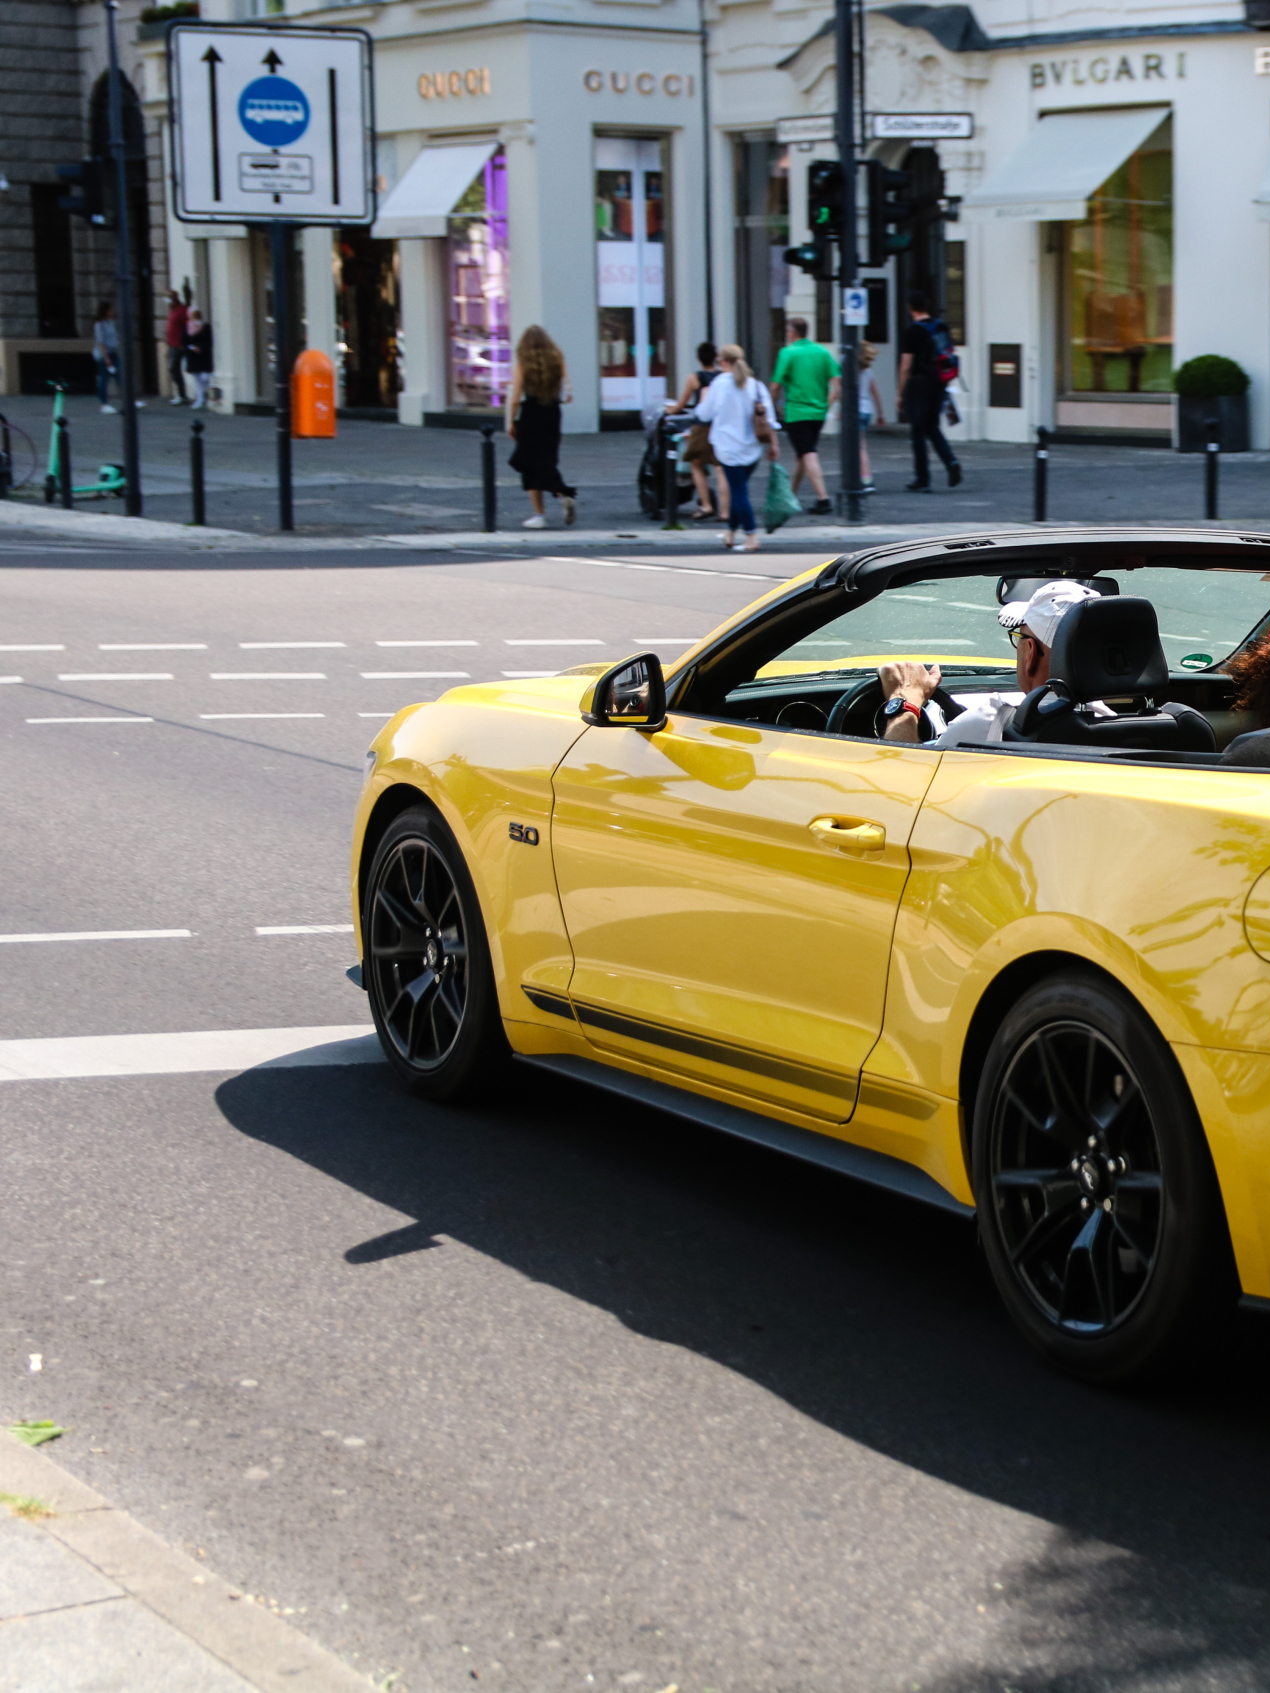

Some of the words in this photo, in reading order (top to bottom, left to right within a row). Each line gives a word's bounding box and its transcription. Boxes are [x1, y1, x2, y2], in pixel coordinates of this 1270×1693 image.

[418, 66, 491, 99] GUCCI
[583, 70, 695, 97] GUCCI
[1030, 52, 1187, 89] BVLGARI
